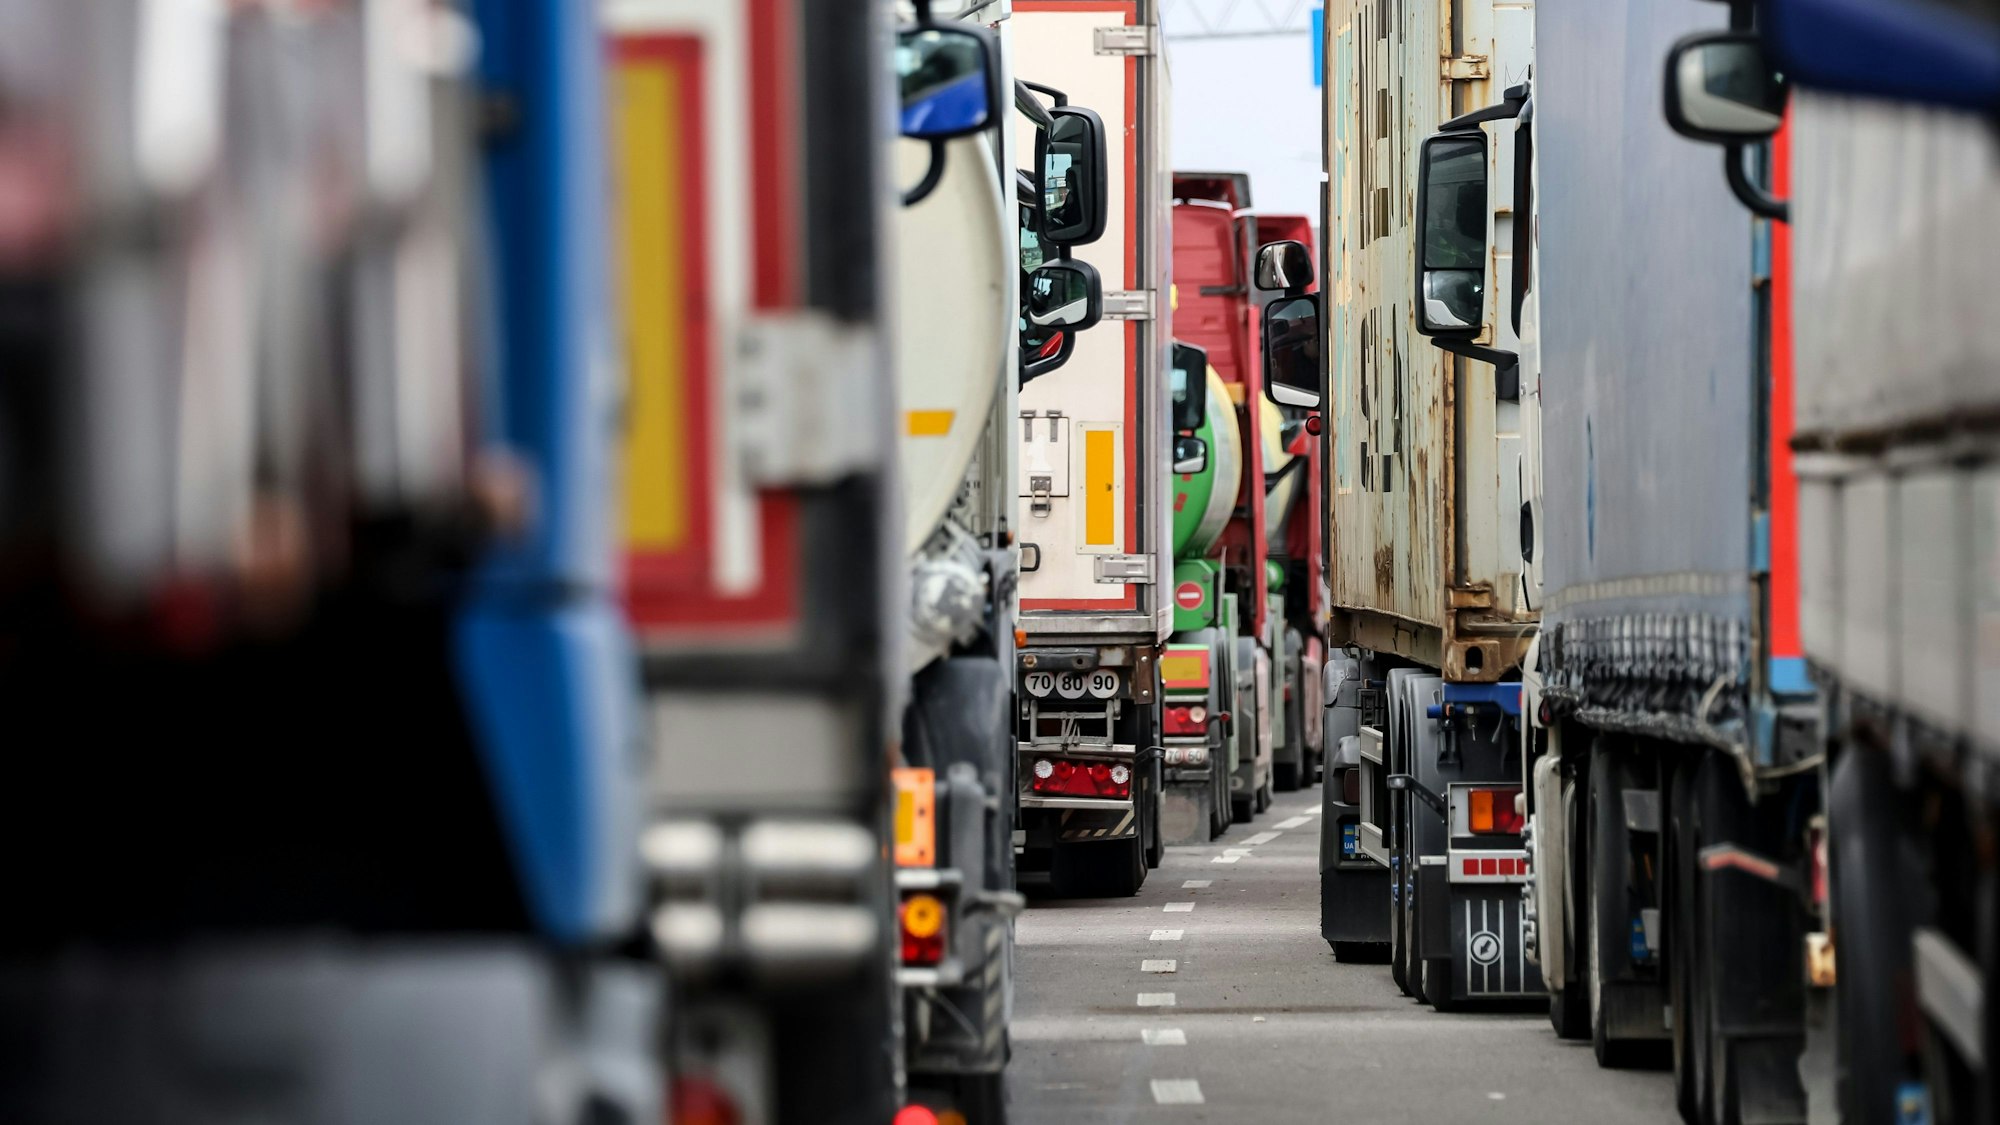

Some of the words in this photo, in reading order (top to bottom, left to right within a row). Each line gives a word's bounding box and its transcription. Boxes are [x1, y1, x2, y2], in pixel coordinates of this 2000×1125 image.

[1031, 675, 1050, 690] 70
[1062, 675, 1083, 691] 80
[1093, 675, 1114, 691] 90
